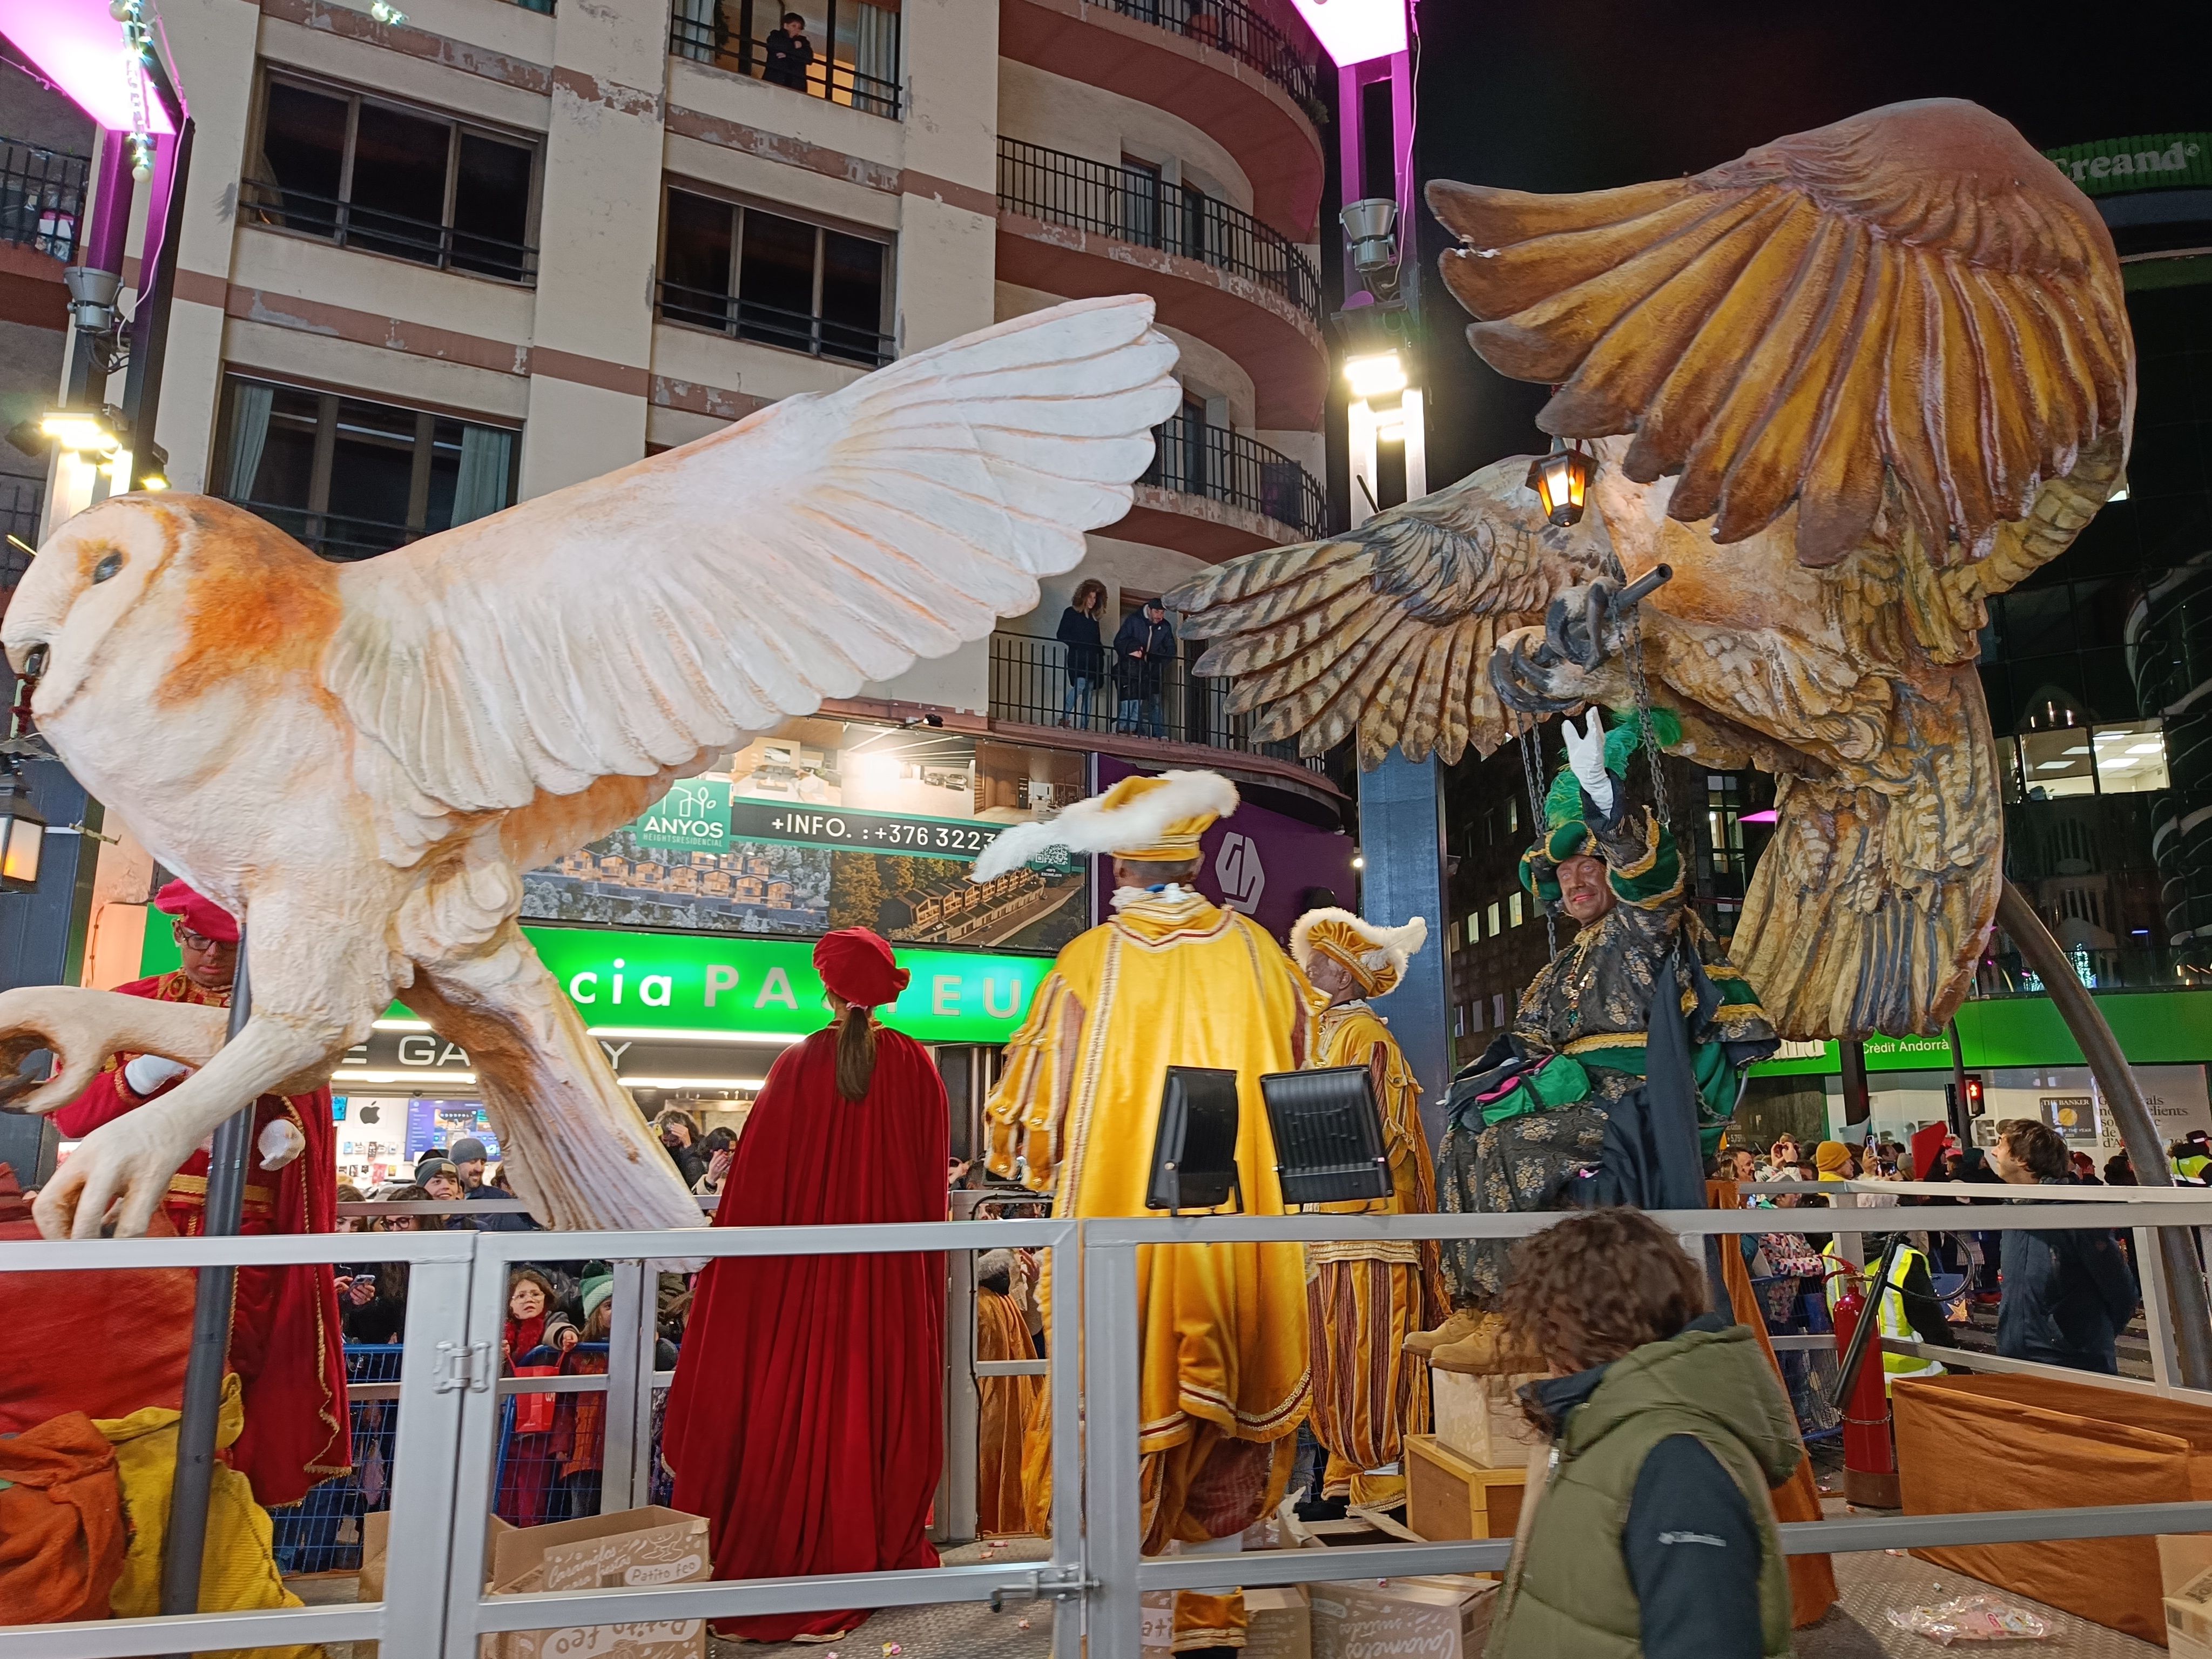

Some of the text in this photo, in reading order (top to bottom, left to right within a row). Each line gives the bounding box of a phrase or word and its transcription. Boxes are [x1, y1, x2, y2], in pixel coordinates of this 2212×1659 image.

[644, 816, 724, 838] ANYOS
[1899, 1039, 1950, 1053] Andorrà
[631, 1562, 696, 1582] Patito feo
